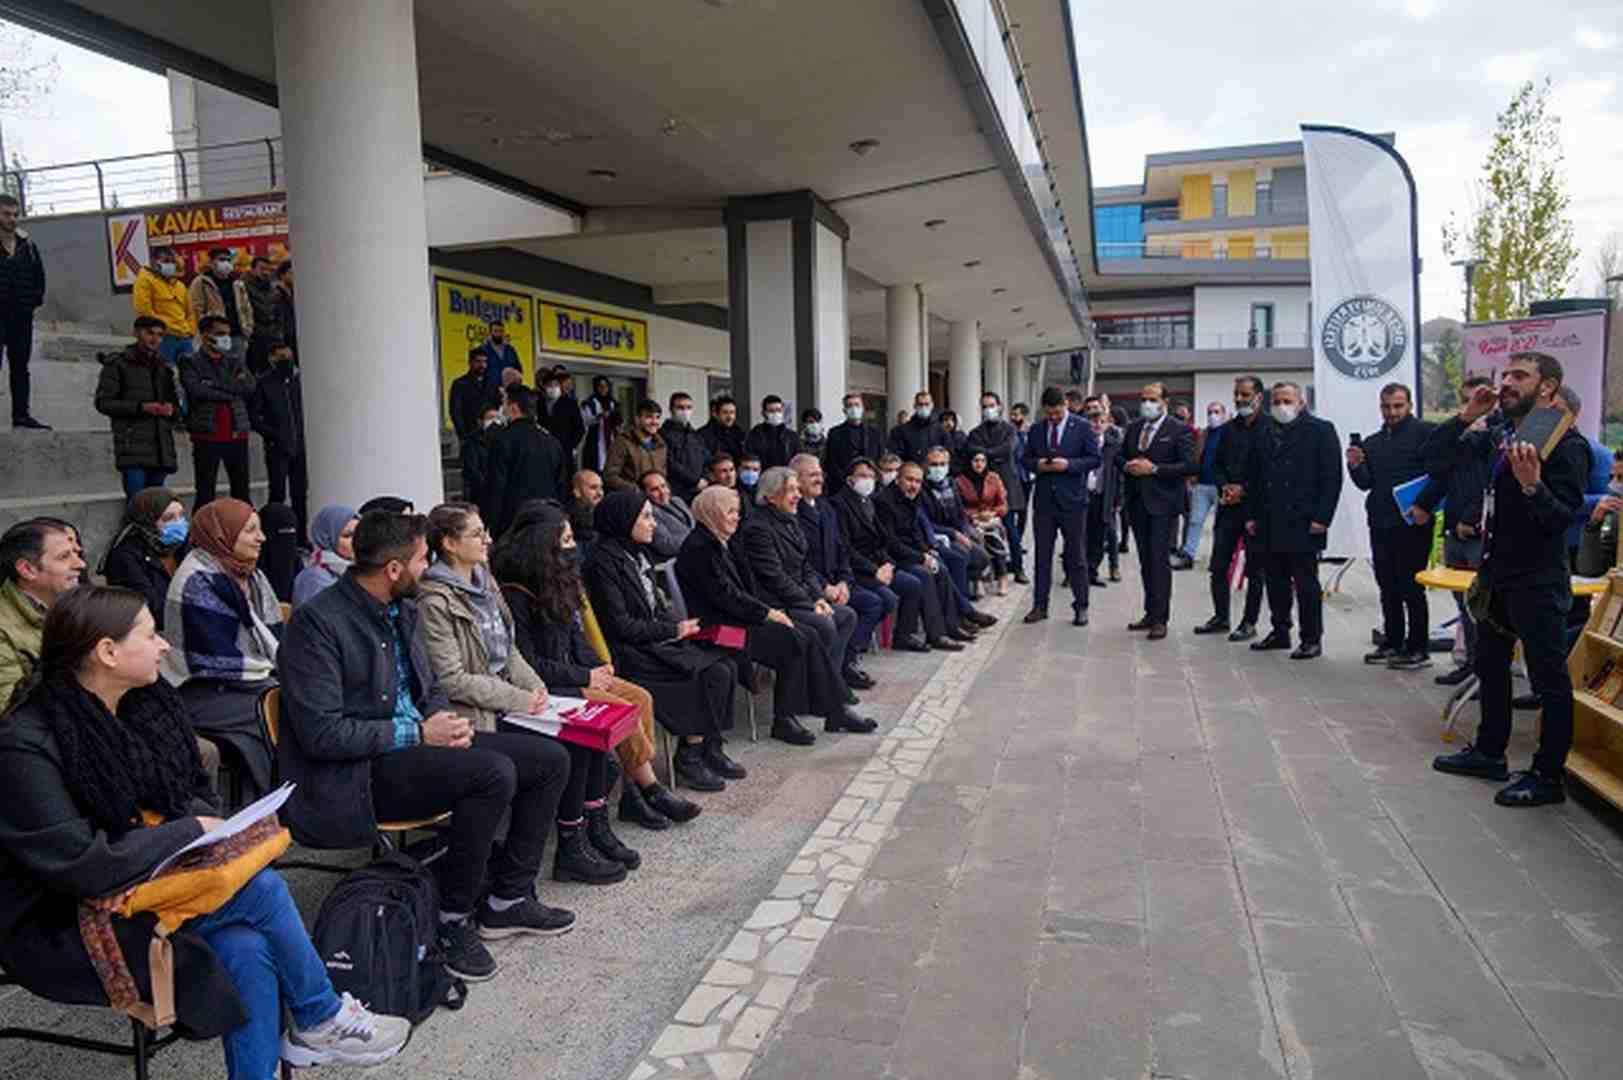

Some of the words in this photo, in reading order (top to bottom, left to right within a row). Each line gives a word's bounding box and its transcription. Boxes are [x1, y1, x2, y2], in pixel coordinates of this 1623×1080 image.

[147, 208, 224, 236] KAVAL
[449, 287, 523, 323] Bulgur's
[556, 312, 635, 350] Bulgur's
